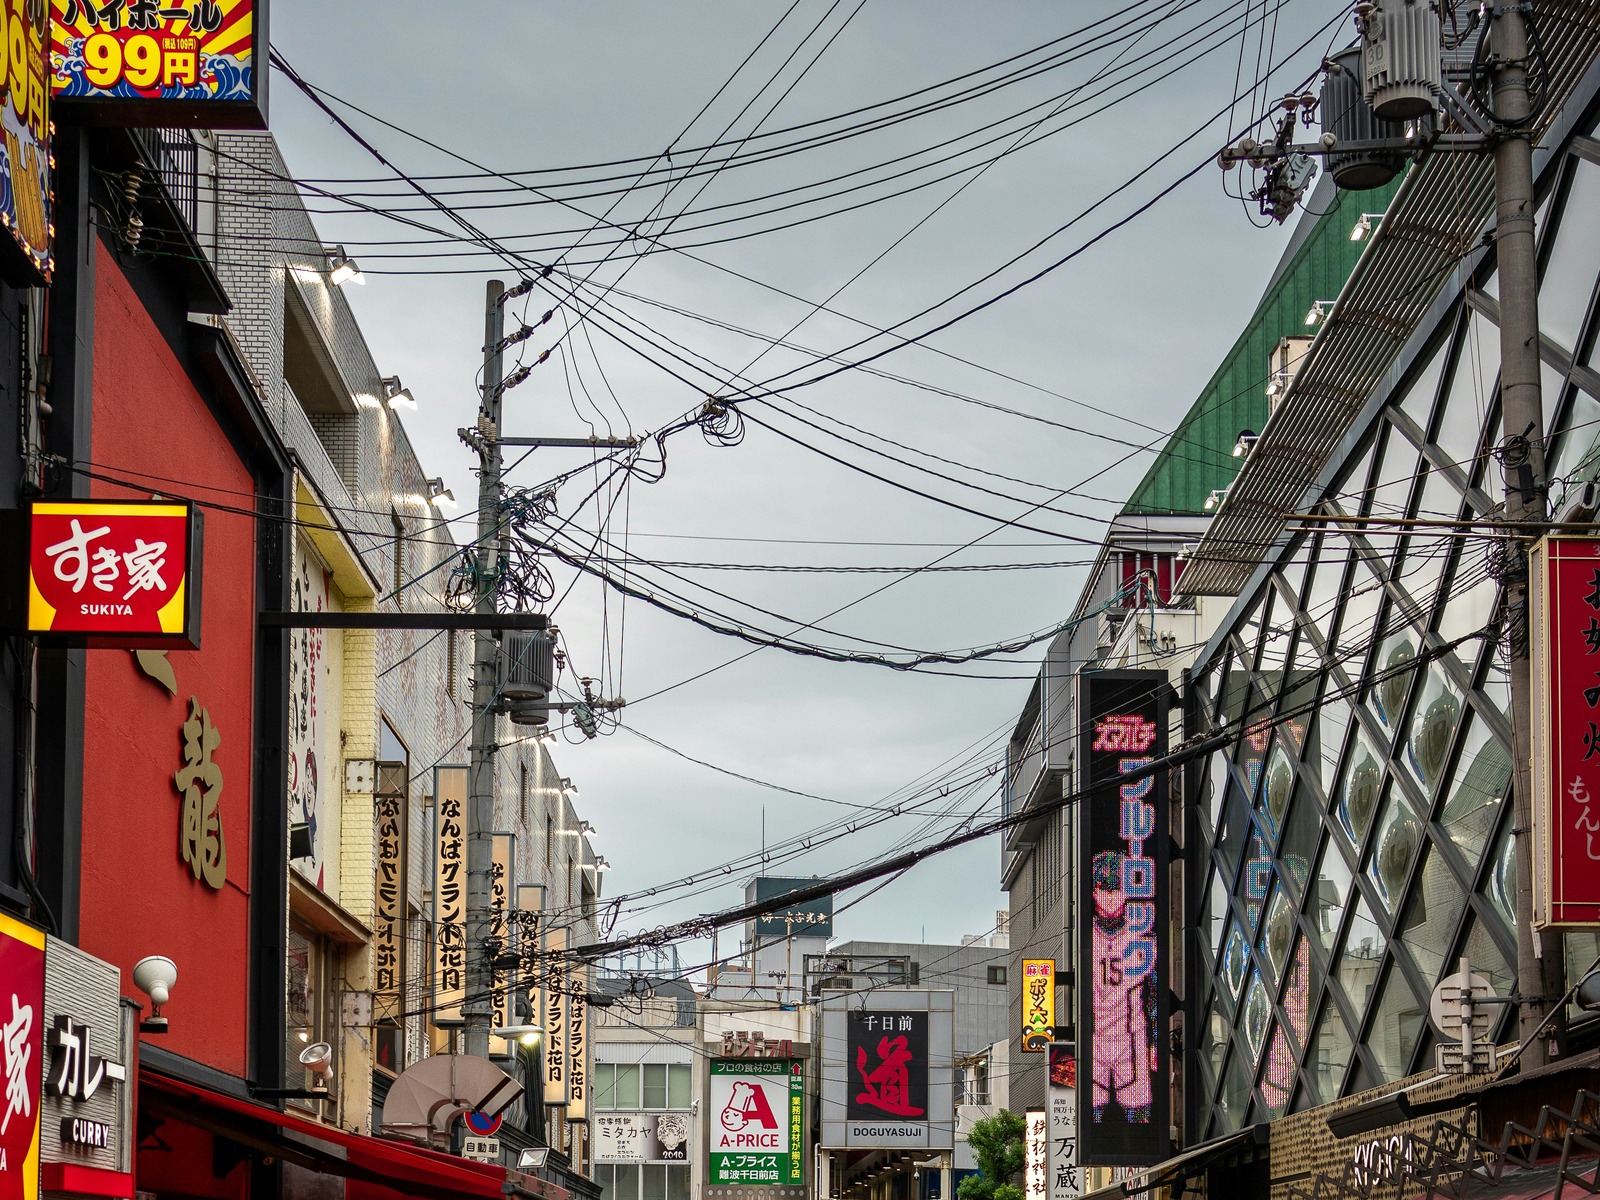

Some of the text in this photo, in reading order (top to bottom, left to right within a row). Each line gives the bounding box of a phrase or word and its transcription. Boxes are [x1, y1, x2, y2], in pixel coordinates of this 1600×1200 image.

[62, 0, 222, 31] ハイボール
[84, 33, 196, 87] 99円
[45, 518, 167, 600] すき家
[80, 603, 133, 616] SUKIYA
[439, 798, 464, 991] なんばグランド花月
[1025, 963, 1050, 976] 麻雀
[863, 1015, 913, 1031] 千日前
[720, 1040, 794, 1057] セントラル
[58, 1016, 126, 1100] カレー
[717, 1062, 782, 1073] プロの食材の店
[855, 1035, 924, 1117] 道
[1053, 1106, 1076, 1114] 四万十
[73, 1117, 109, 1148] CURRY
[602, 1126, 652, 1139] ミタカヤ
[791, 1096, 801, 1179] 業務用食材が揃う店
[853, 1128, 922, 1137] DOGUYASUJI
[466, 1142, 498, 1153] 自動車
[720, 1133, 779, 1148] A-PRICE
[662, 1150, 684, 1159] 2010
[720, 1155, 778, 1168] A-プライス
[1054, 1136, 1079, 1192] 万蔵
[719, 1169, 779, 1180] 難波千日前店
